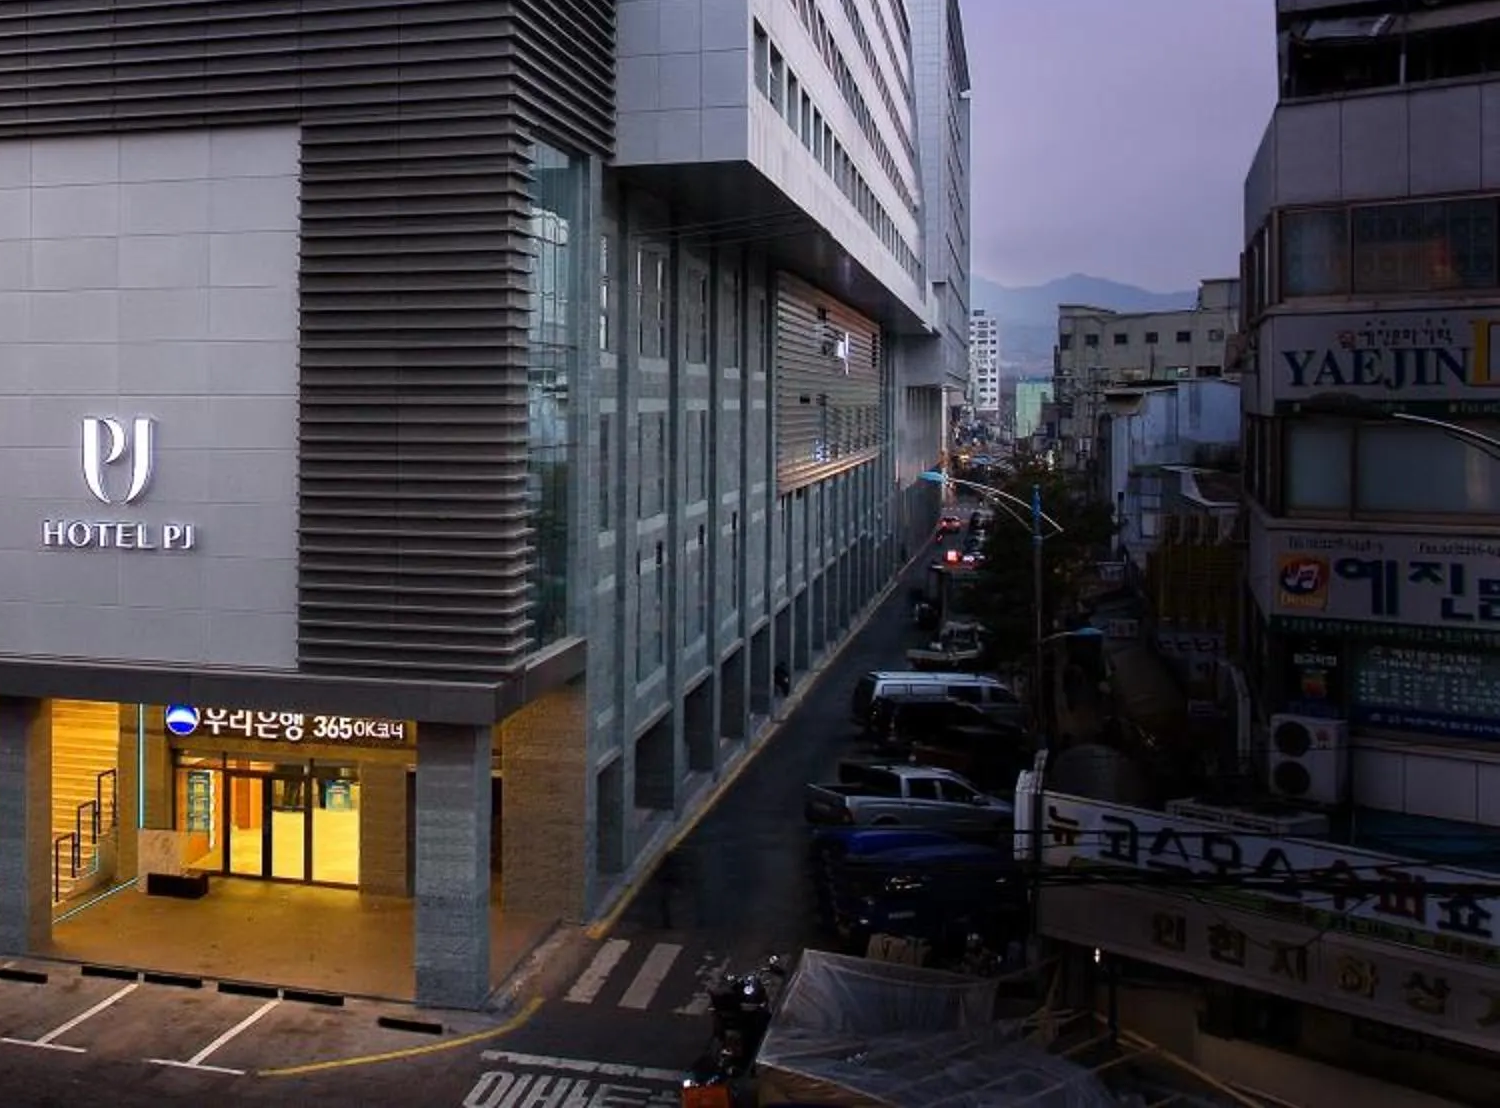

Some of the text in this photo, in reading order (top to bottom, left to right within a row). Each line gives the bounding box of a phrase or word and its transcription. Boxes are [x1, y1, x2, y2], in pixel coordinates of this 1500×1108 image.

[1282, 348, 1471, 389] YAEJIN
[42, 520, 196, 550] HOTEL PJ
[203, 708, 305, 740] 우리은행
